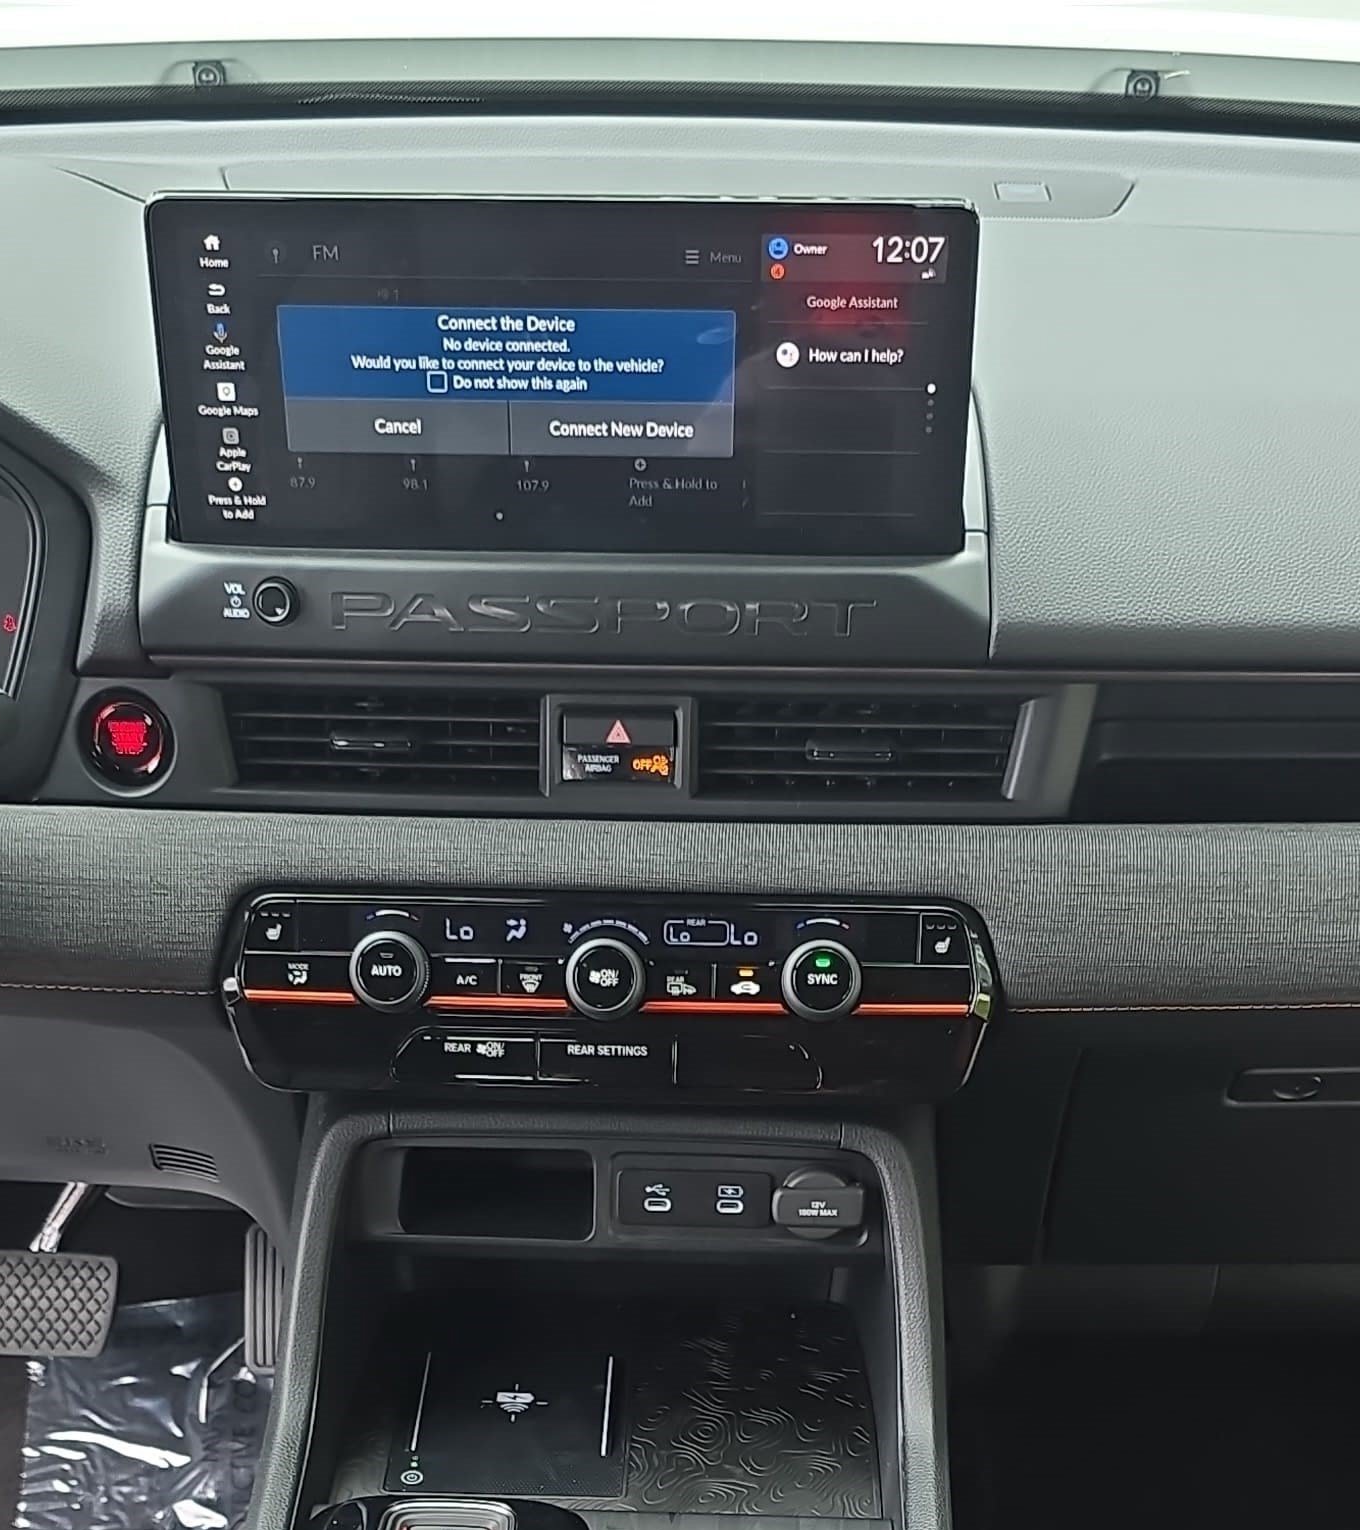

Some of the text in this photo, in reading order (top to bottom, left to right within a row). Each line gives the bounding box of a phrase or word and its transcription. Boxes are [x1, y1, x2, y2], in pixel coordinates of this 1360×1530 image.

[312, 245, 339, 261] FM
[793, 243, 828, 256] Owner
[872, 236, 945, 264] 12:07
[199, 257, 229, 268] Home
[710, 250, 741, 264] Menu
[206, 303, 231, 314] Back
[806, 296, 899, 311] Google Assistant
[437, 315, 576, 332] Connect the Device
[205, 345, 240, 357] Google
[443, 337, 571, 353] No device connected.
[808, 348, 838, 363] How
[840, 350, 862, 363] can
[871, 349, 904, 365] help?
[203, 359, 246, 371] Assistant
[350, 355, 665, 374] Would you like to connect your device to the vehicle?
[453, 375, 588, 393] Do not show this again
[198, 404, 259, 417] Google Maps
[374, 418, 422, 435] Cancel
[549, 420, 695, 438] Connect New Device
[219, 446, 247, 458] Apple
[216, 461, 252, 472] CarPlay
[290, 476, 316, 488] 87.9
[403, 478, 429, 490] 98.1
[516, 480, 550, 492] 107.9
[628, 477, 718, 490] Press & Hold to
[243, 495, 267, 506] Hold
[628, 495, 653, 507] Add
[235, 509, 255, 520] Add
[223, 581, 246, 595] VOL
[331, 590, 878, 637] PASSPORT
[577, 754, 620, 764] PASSENGER
[632, 758, 652, 771] OFF
[686, 918, 707, 927] REAR
[445, 918, 475, 940] Lo
[669, 927, 691, 943] Lo
[730, 924, 758, 945] Lo
[288, 963, 309, 971] MODE
[370, 965, 403, 977] AUTO
[600, 969, 619, 979] ON/
[807, 973, 838, 986] SYNC
[456, 975, 478, 986] A/C
[600, 978, 619, 988] OFF
[444, 1042, 472, 1053] REAR
[567, 1044, 648, 1057] REAR SETTINGS
[486, 1049, 505, 1059] OFF
[820, 1209, 838, 1217] MAX
